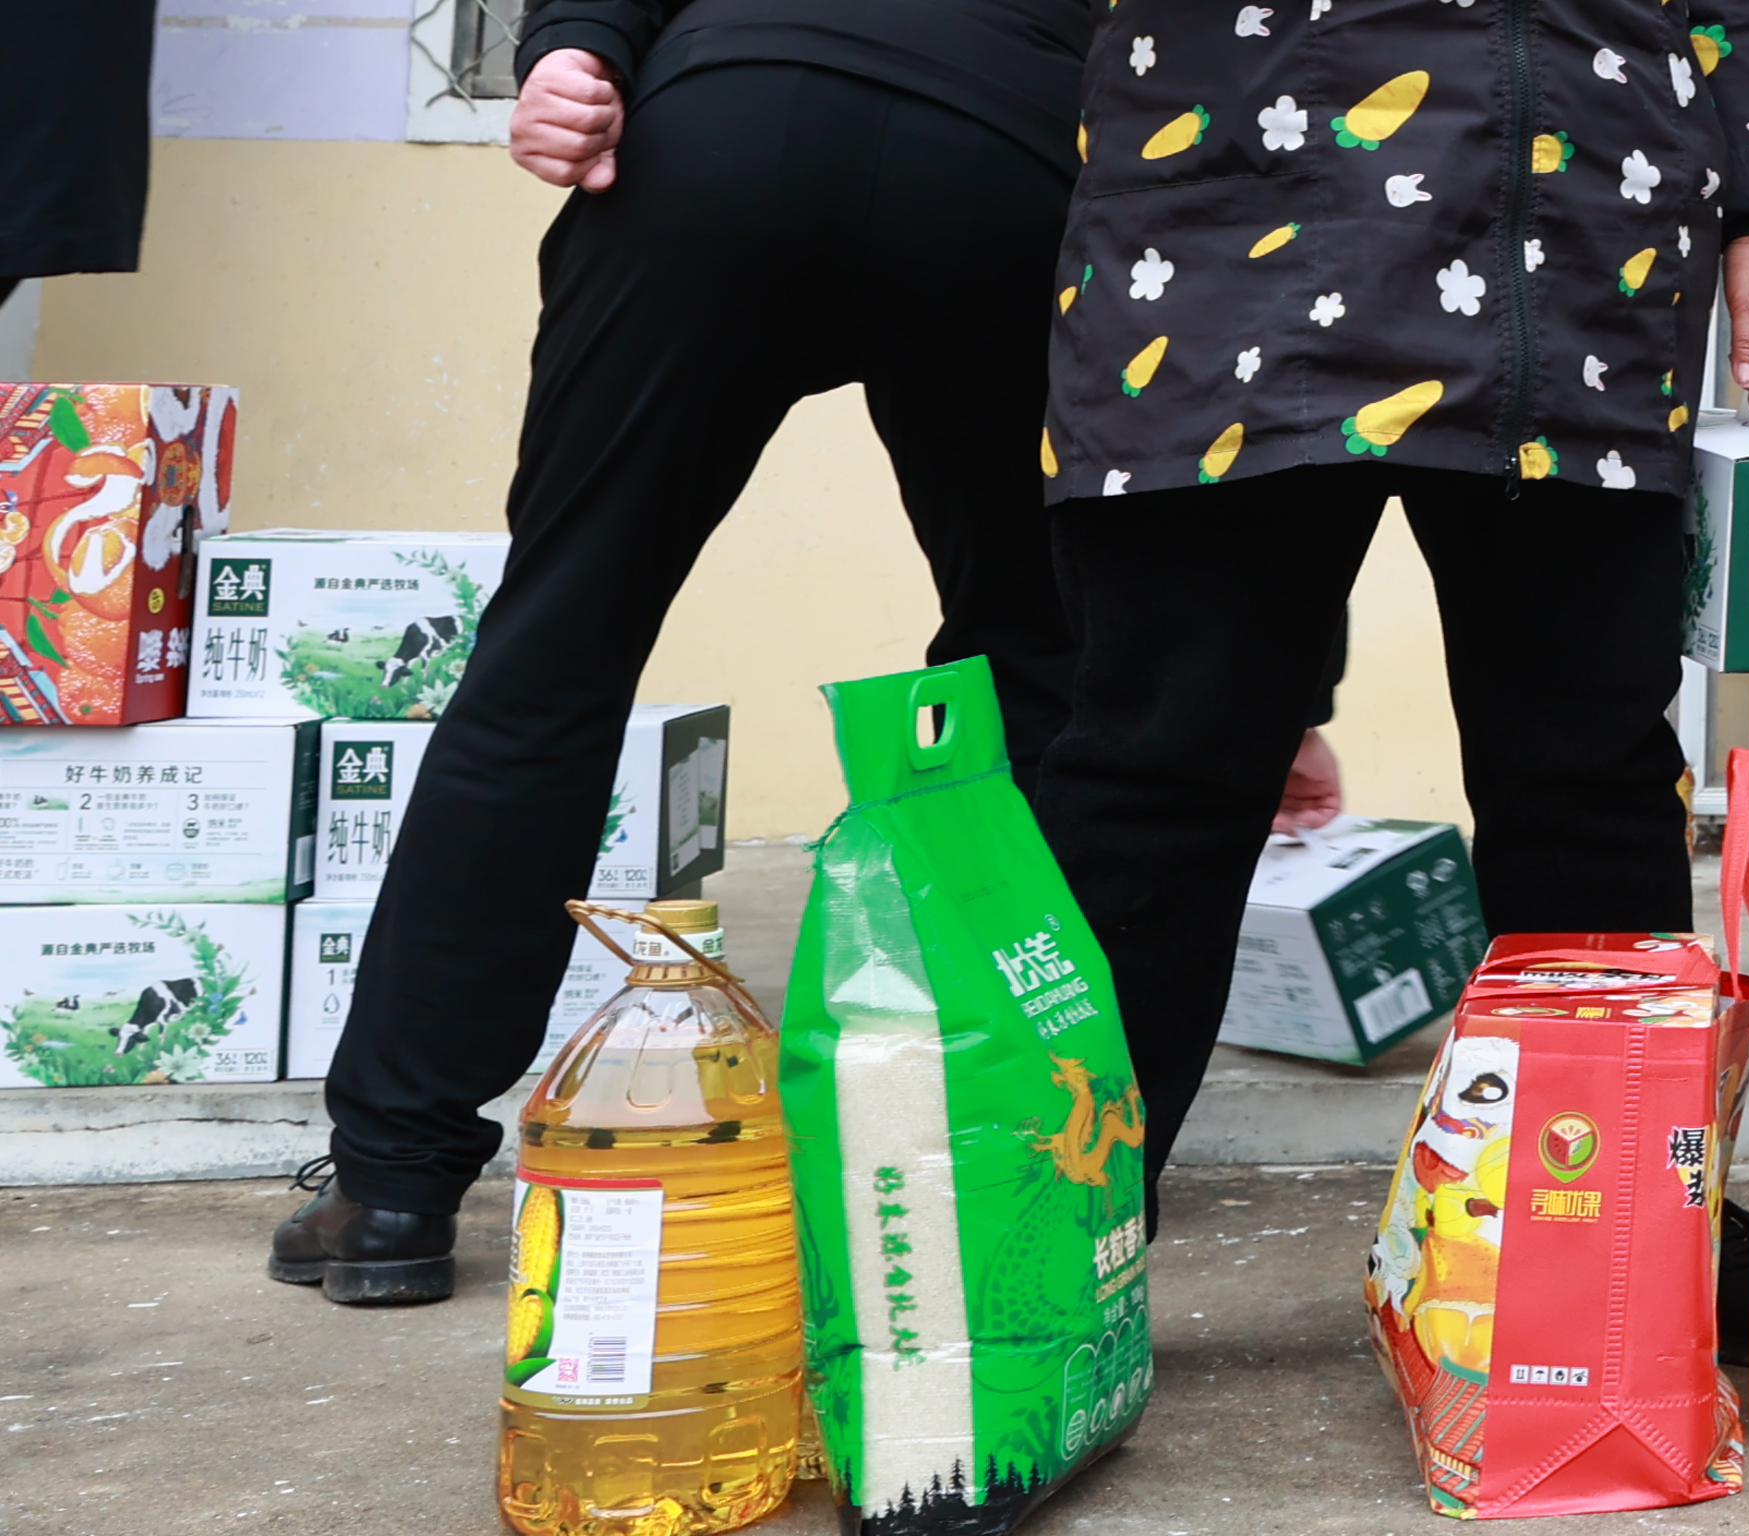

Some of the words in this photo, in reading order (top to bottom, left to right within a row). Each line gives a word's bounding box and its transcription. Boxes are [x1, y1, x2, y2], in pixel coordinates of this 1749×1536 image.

[213, 564, 267, 601] 金典
[314, 577, 420, 591] 源自金典严选牧场
[212, 602, 265, 612] SATINE
[202, 627, 269, 682] 纯牛奶
[65, 765, 203, 784] 好牛奶养成记
[336, 747, 390, 783] 金典
[335, 785, 388, 794] SATINE
[79, 793, 92, 810] 2
[187, 793, 199, 811] 3
[327, 811, 392, 865] 纯牛奶
[41, 942, 156, 957] 源自金典严选牧场
[992, 931, 1076, 998] 北大荒
[1531, 1189, 1602, 1217] 寻味优果
